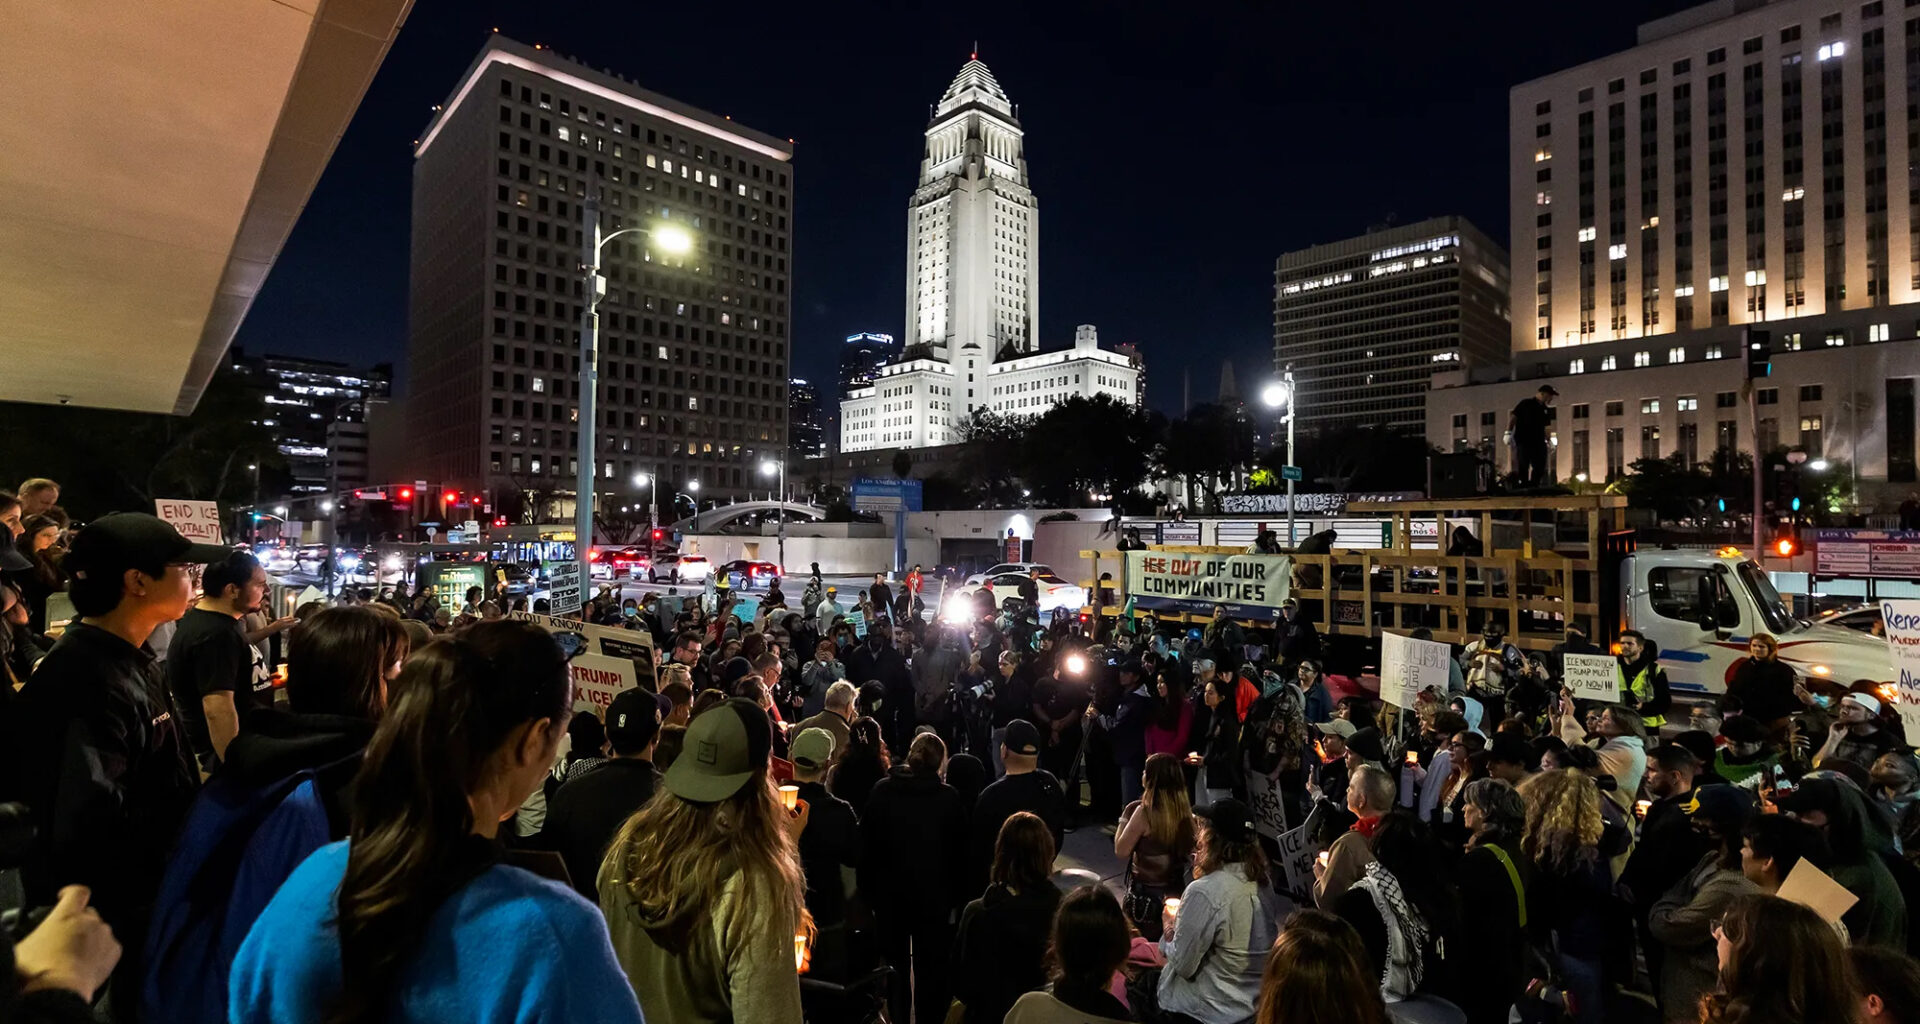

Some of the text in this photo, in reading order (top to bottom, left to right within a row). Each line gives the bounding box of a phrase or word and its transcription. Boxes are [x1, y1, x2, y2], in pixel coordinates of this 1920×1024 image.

[162, 504, 220, 521] END ICE
[1142, 557, 1266, 580] ICE OUT OF OUR
[552, 587, 579, 598] STOP
[1143, 577, 1265, 601] COMMUNITIES
[552, 599, 561, 609] ICE
[549, 617, 584, 632] KNOW
[1384, 637, 1450, 670] ABOLISH
[1566, 656, 1579, 667] ICE
[572, 666, 623, 688] TRUMP!
[1393, 663, 1419, 689] ICE
[1567, 668, 1592, 677] TRUMP
[1570, 679, 1583, 688] GO
[1280, 831, 1302, 858] ICE
